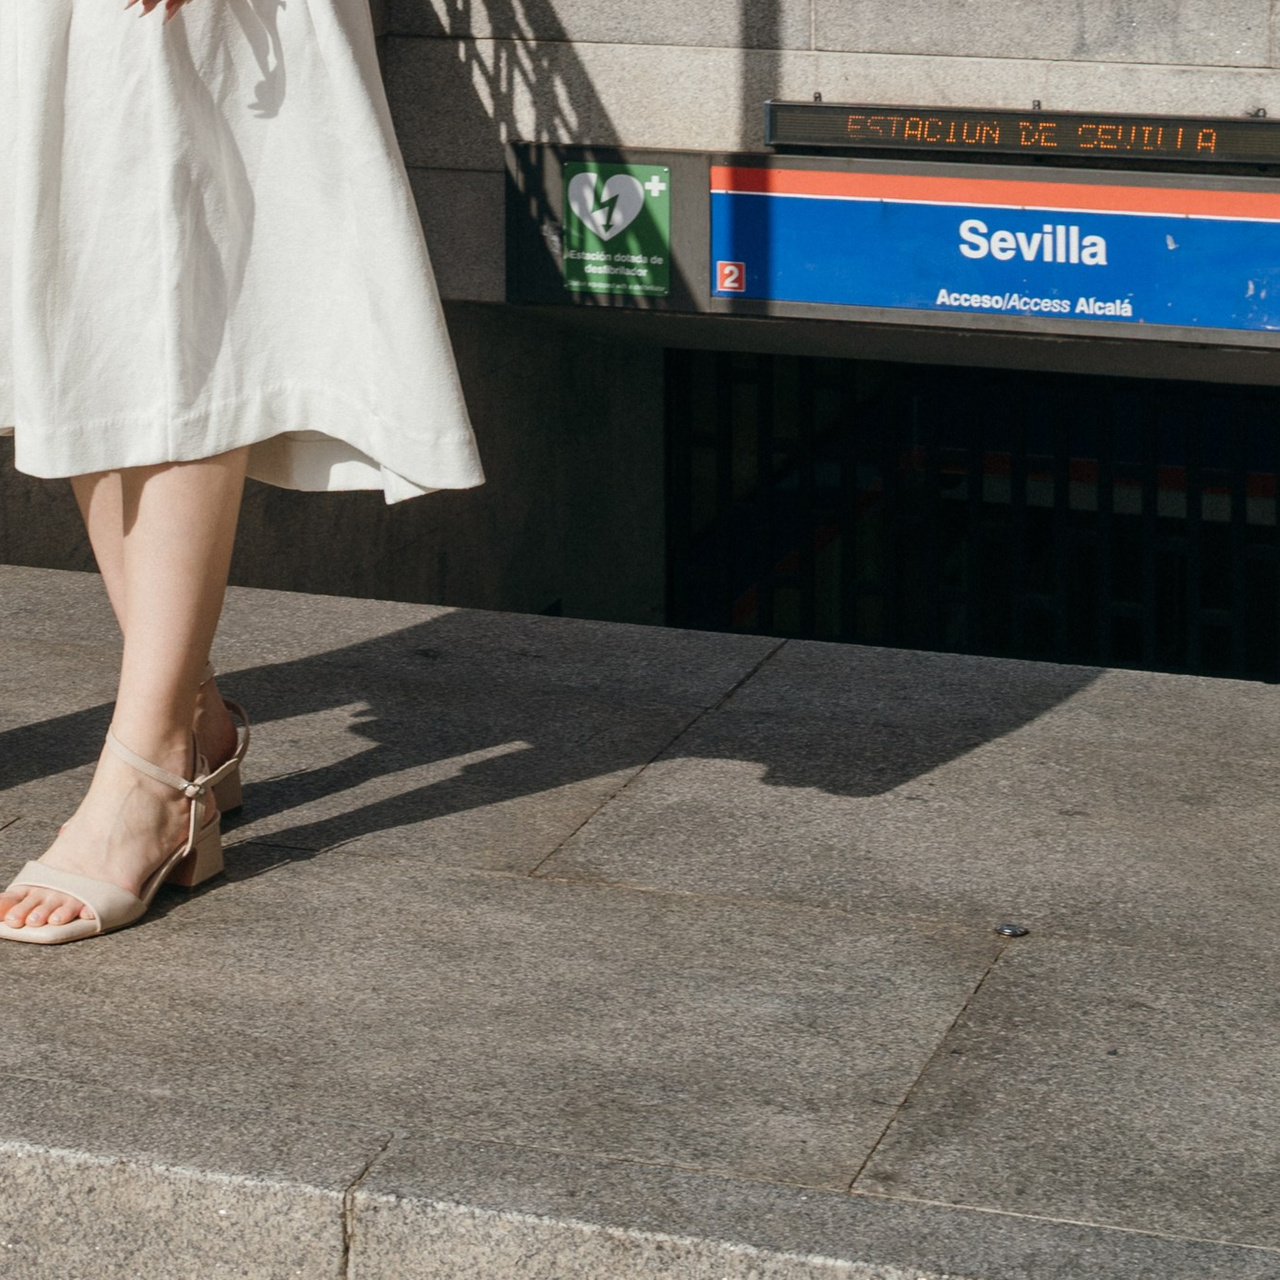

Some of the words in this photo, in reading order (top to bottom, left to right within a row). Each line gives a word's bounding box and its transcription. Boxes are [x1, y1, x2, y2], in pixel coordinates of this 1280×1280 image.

[1019, 121, 1058, 147] DE
[958, 219, 1108, 266] Sevilla
[650, 255, 664, 265] de
[723, 265, 740, 288] 2
[1074, 296, 1133, 317] Alcalá
